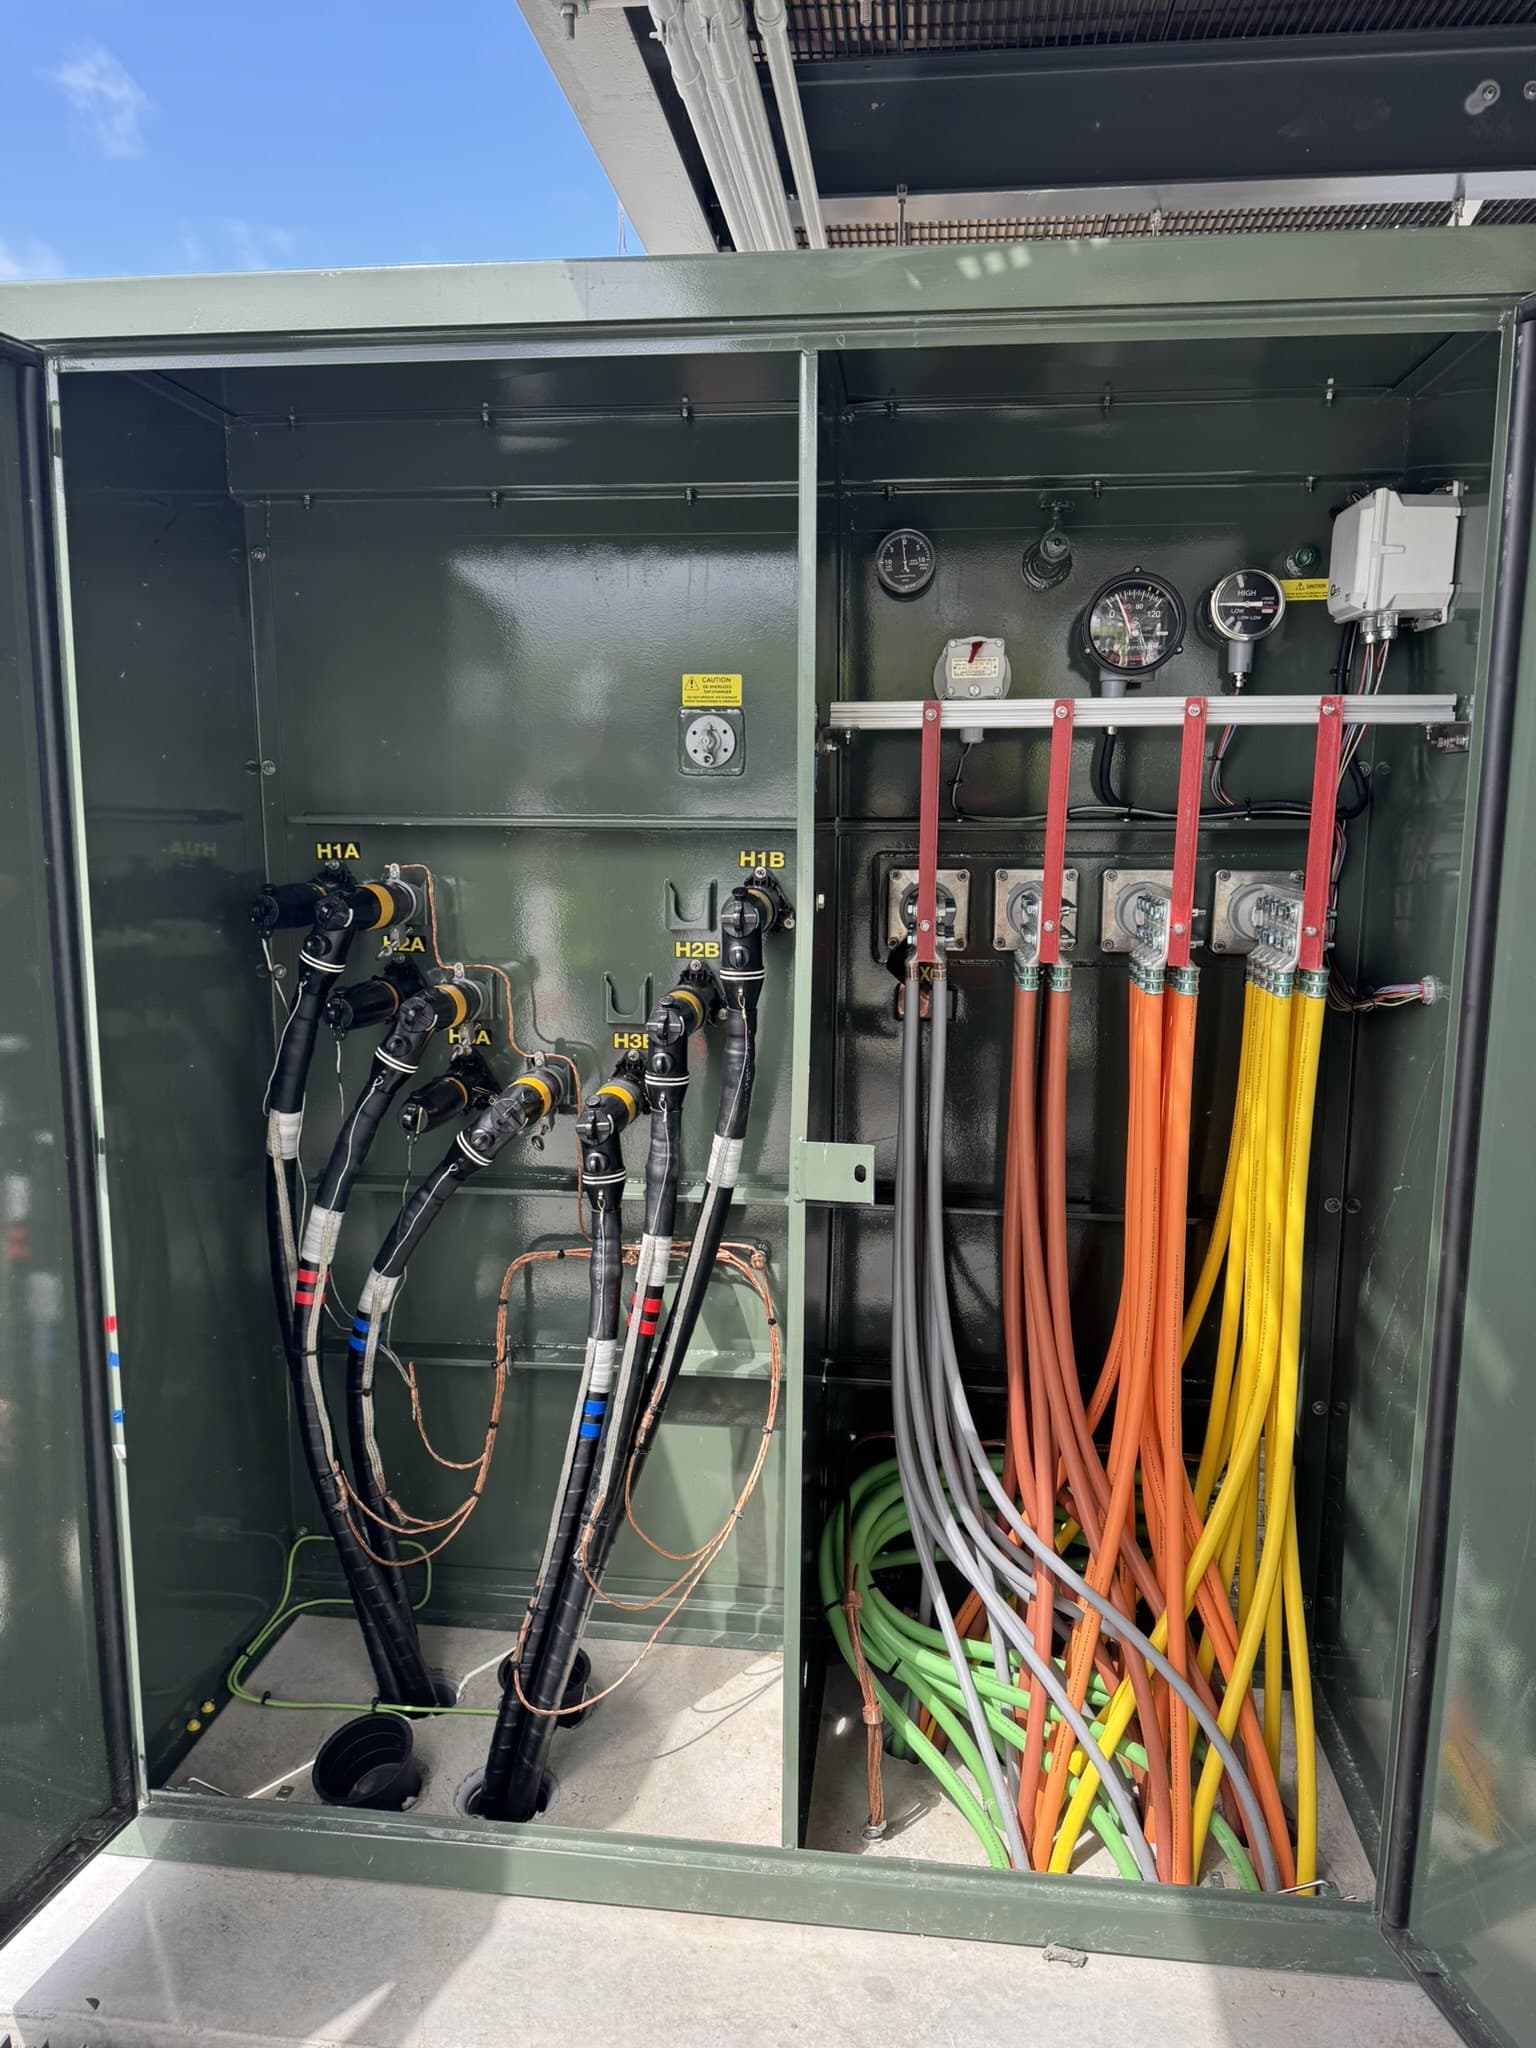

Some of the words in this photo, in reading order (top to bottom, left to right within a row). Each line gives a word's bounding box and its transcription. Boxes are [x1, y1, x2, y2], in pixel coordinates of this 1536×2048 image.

[1237, 589, 1257, 597] HIGH
[1109, 609, 1116, 618] 0
[1147, 610, 1161, 618] 120
[316, 842, 360, 860] H1A
[738, 851, 785, 868] H1B
[674, 941, 720, 958] H2B
[447, 1028, 491, 1045] HA
